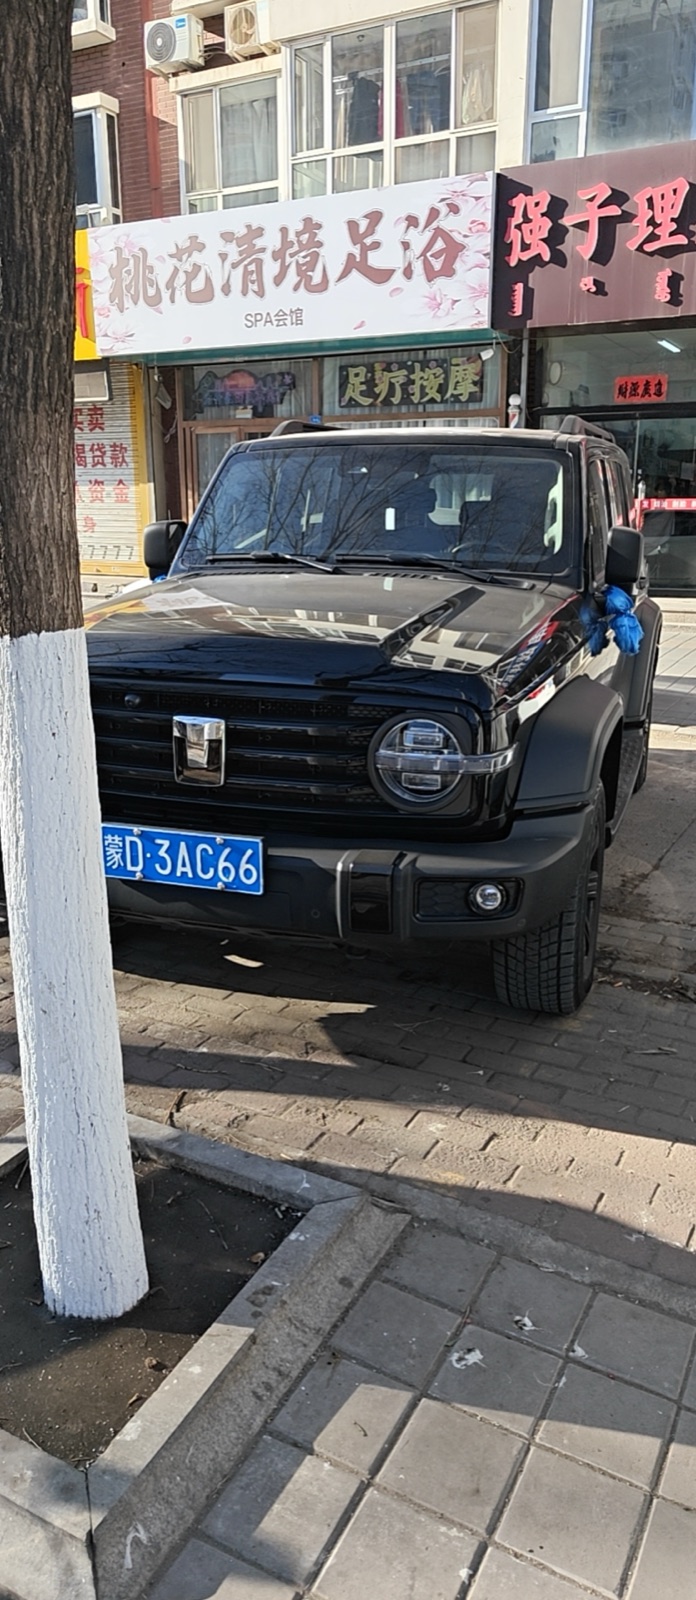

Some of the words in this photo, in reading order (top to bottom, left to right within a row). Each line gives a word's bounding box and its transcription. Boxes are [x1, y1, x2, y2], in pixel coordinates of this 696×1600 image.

[504, 176, 690, 268] 强子理
[108, 202, 467, 314] 桃花清境足浴
[244, 306, 304, 329] SPA会馆
[343, 357, 481, 406] 足疗按摩
[74, 478, 130, 504] 资金
[79, 544, 135, 560] 7777
[103, 834, 258, 886] 蒙D·3AC66
